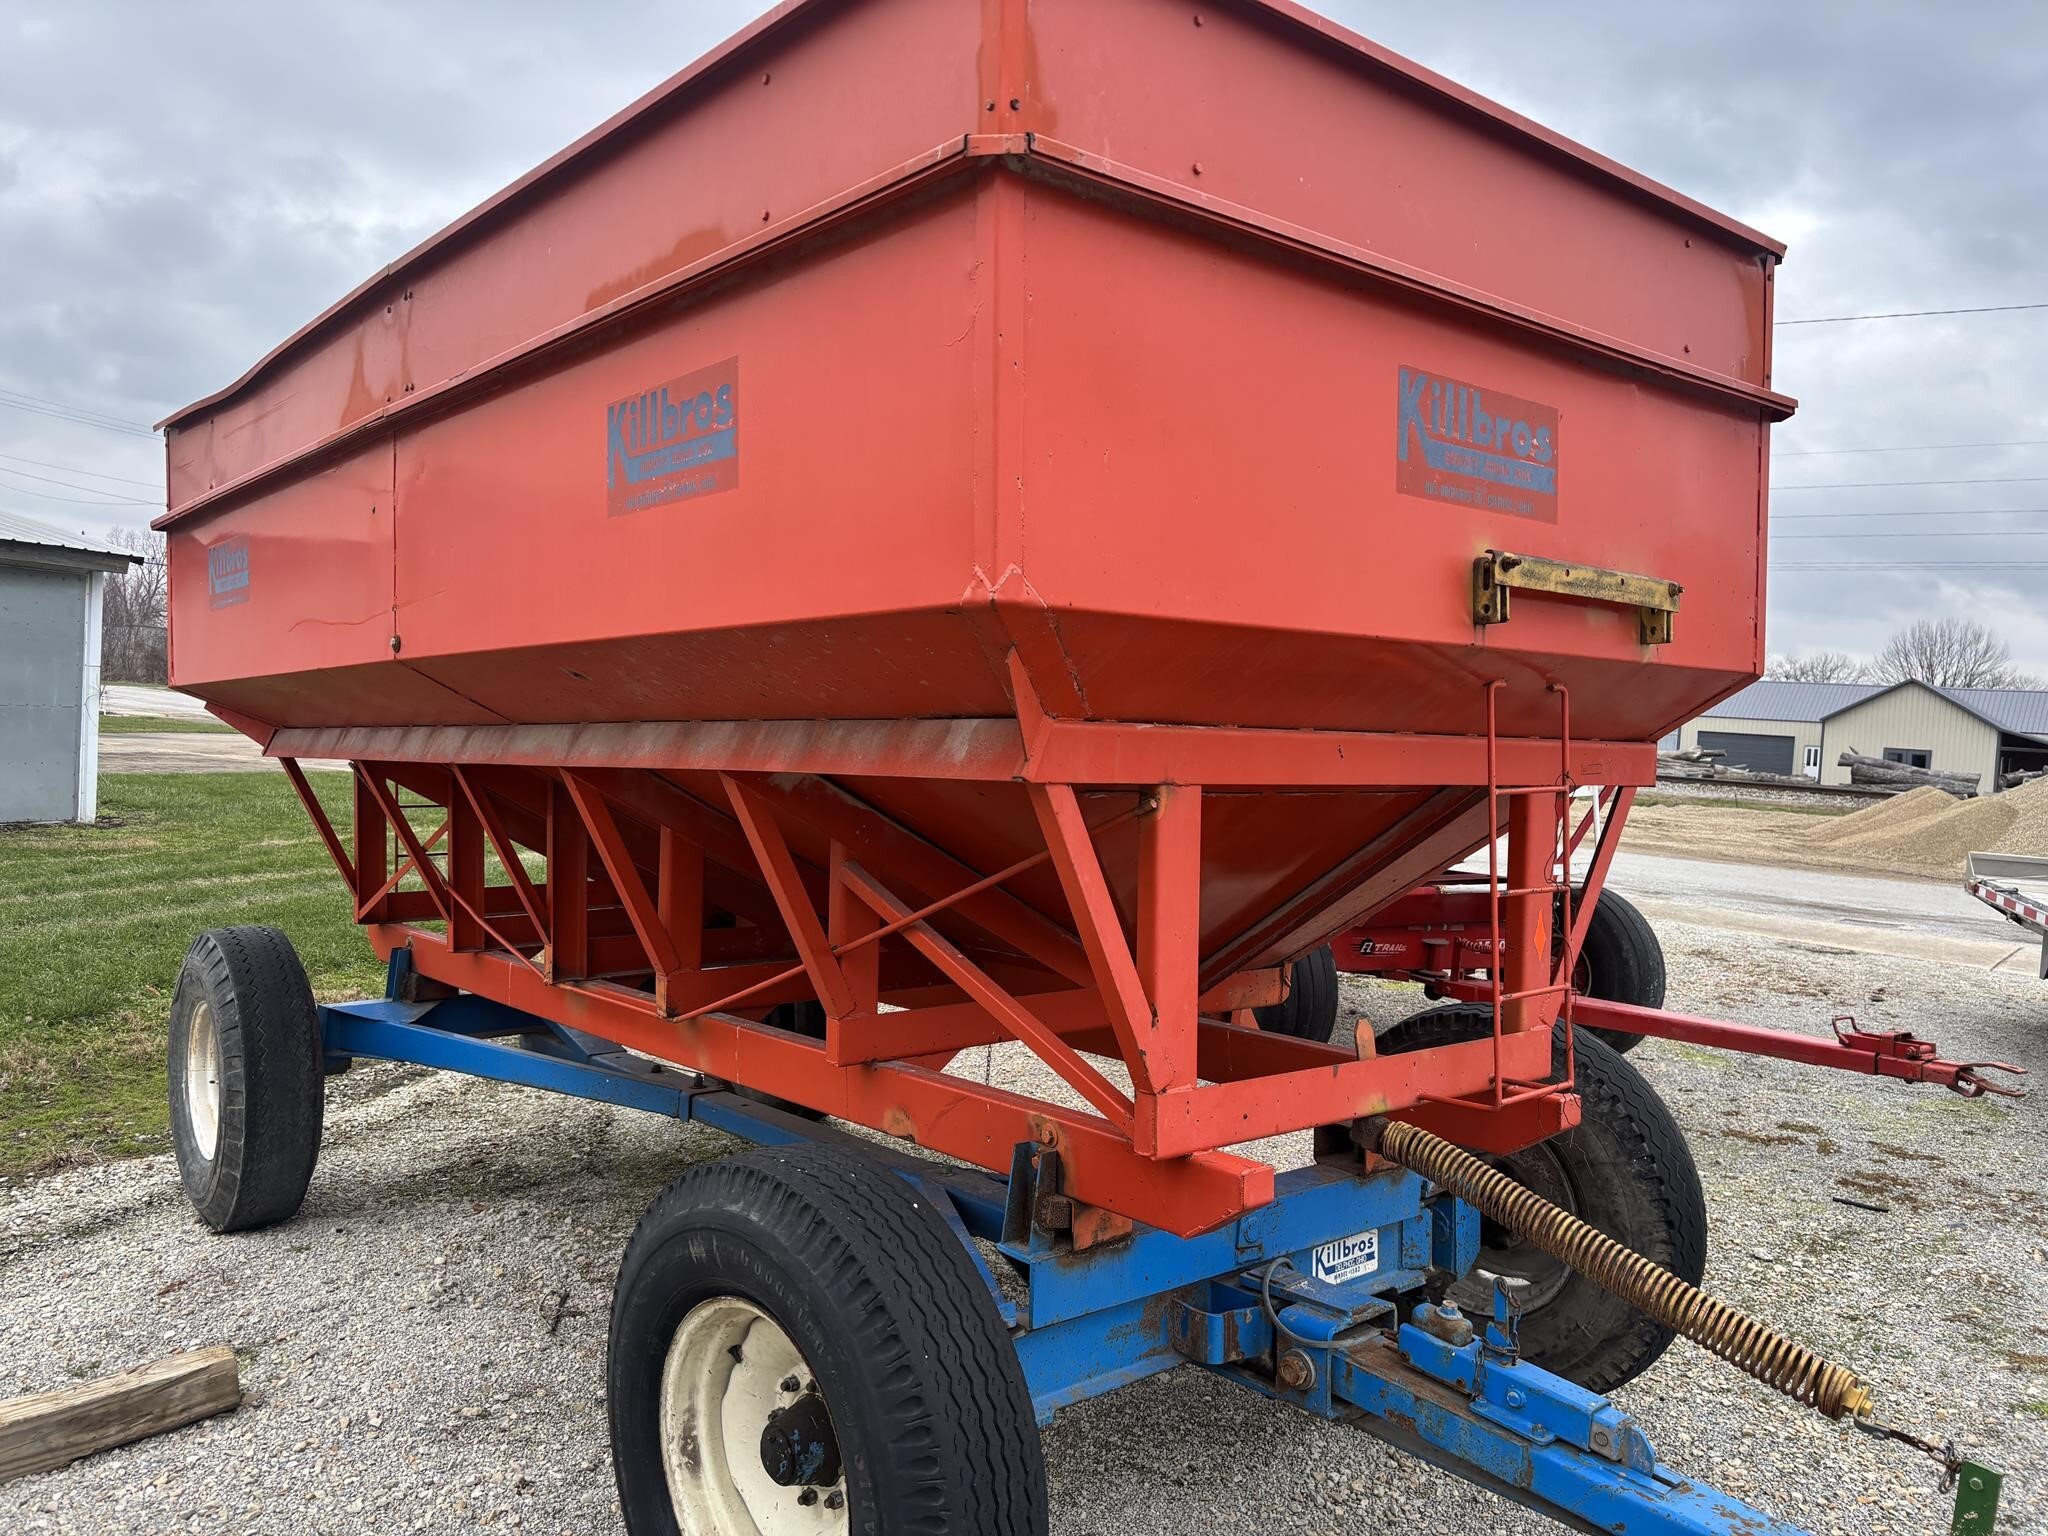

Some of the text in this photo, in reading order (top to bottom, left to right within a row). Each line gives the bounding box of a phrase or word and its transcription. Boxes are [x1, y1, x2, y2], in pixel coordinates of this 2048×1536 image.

[607, 383, 734, 491] Killbros
[1399, 369, 1553, 463] Killbros
[1315, 1237, 1374, 1278] Killbros
